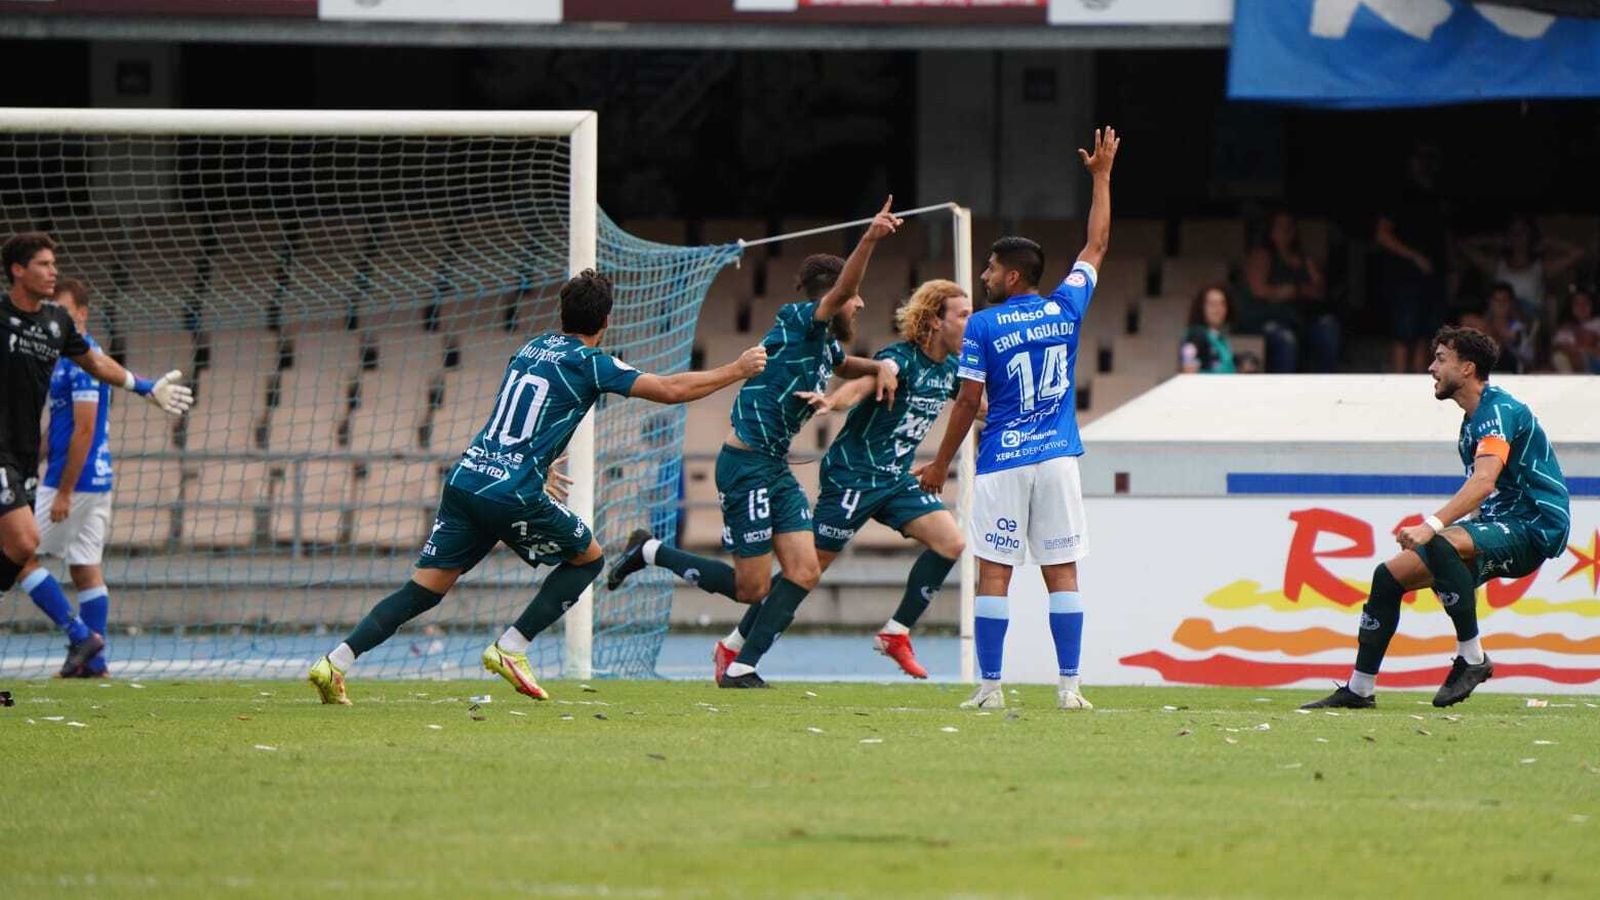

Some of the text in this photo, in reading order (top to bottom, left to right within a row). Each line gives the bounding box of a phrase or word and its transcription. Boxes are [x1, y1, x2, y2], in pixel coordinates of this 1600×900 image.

[997, 308, 1044, 325] indeso
[992, 332, 1024, 353] ERIK
[1026, 322, 1075, 342] AGUADO
[1006, 343, 1070, 415] 14
[486, 369, 549, 445] 10
[1022, 439, 1069, 456] DEPORTIVO
[748, 488, 770, 521] 15
[841, 488, 861, 520] 4
[985, 532, 1020, 550] alpha
